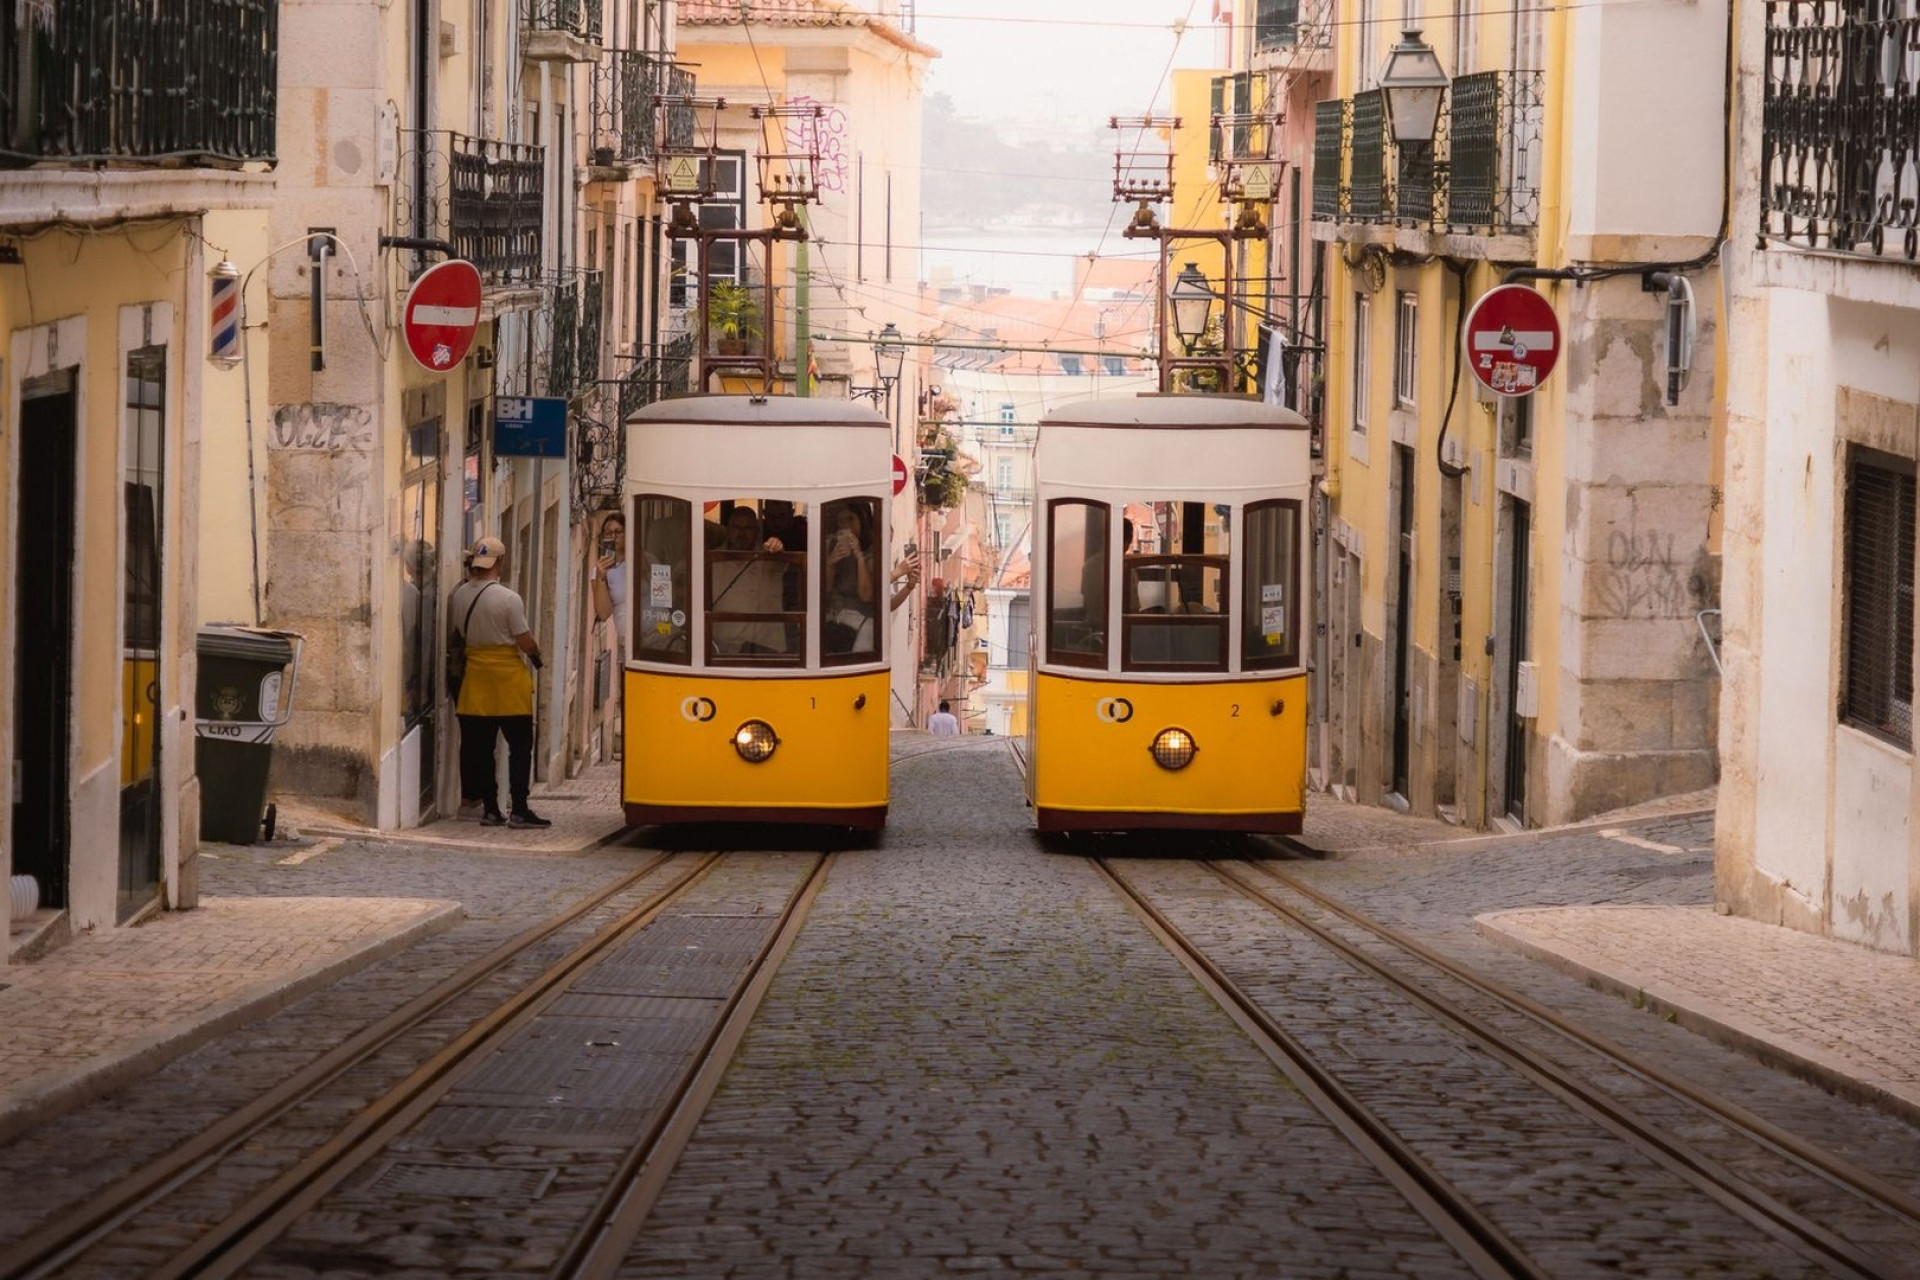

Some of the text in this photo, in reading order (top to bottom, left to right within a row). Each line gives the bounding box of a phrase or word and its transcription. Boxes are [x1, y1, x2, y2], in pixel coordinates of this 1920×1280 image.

[497, 399, 533, 419] BH
[810, 696, 816, 710] 1
[1231, 704, 1240, 717] 2
[208, 725, 241, 737] LIXO
